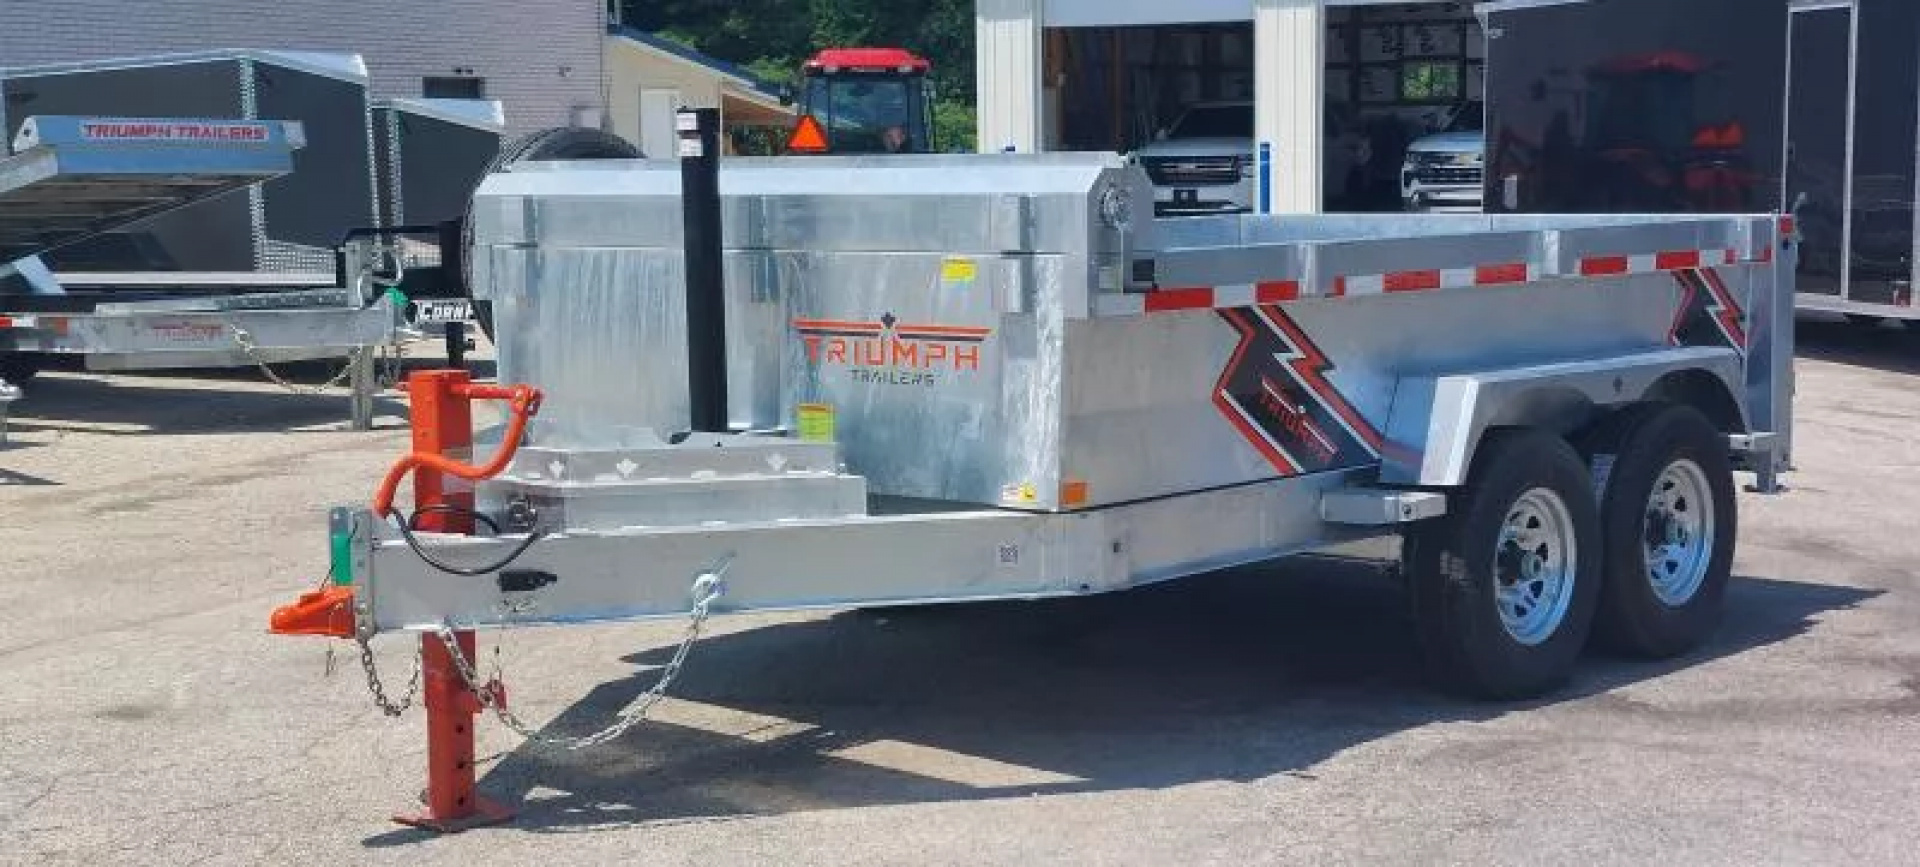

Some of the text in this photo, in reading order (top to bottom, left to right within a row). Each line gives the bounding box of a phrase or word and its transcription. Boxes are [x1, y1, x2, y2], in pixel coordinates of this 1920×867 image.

[84, 124, 265, 140] TRIUMPH TRAILERS
[805, 336, 980, 371] TRIUMPH
[851, 369, 936, 386] TRAILERS
